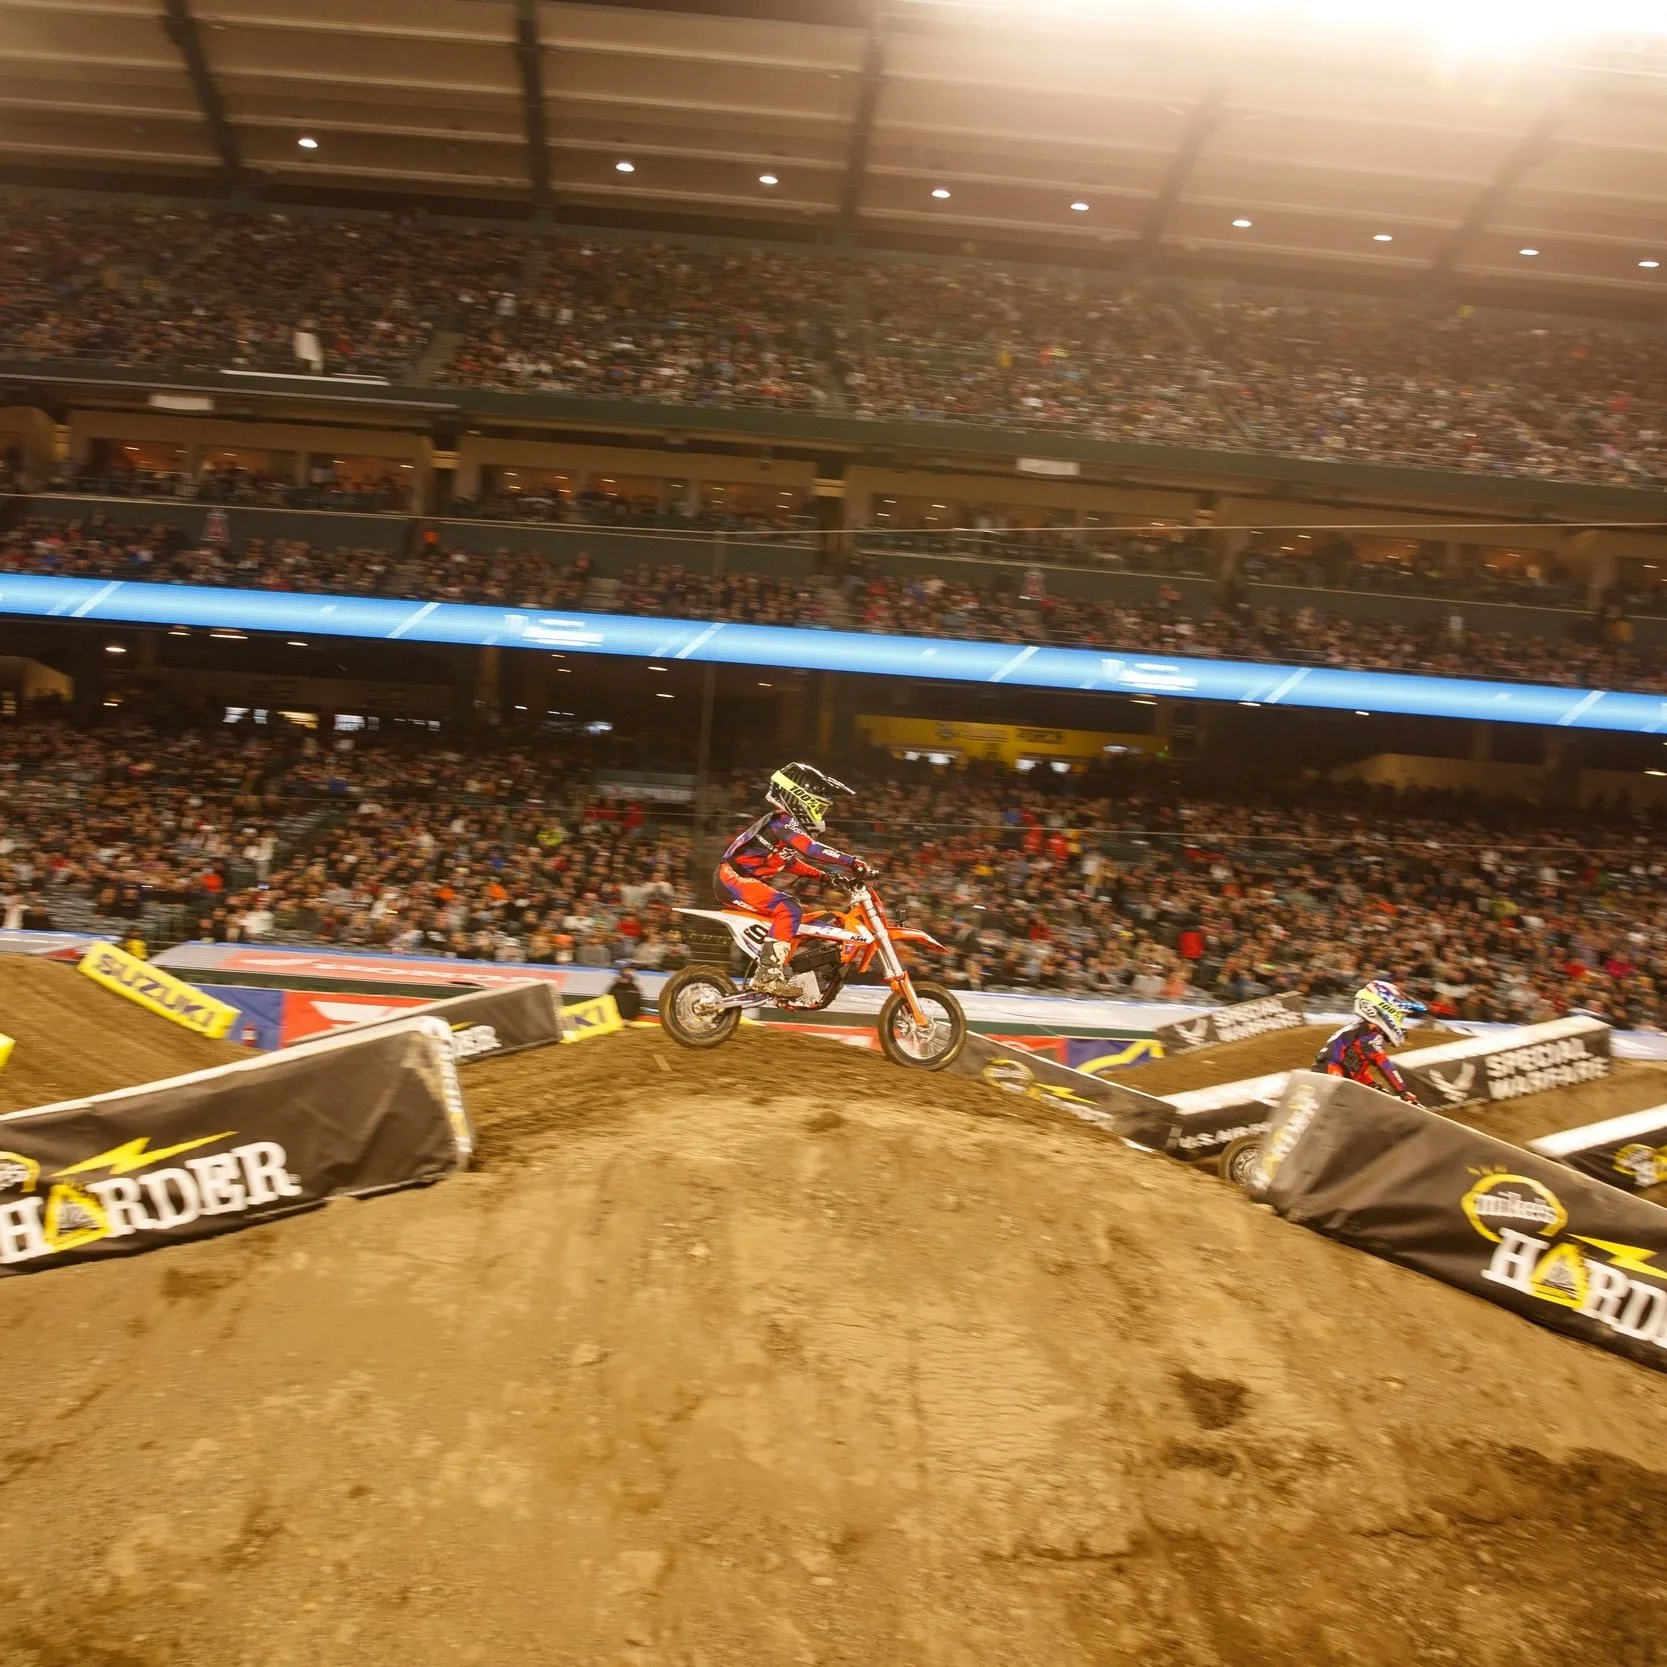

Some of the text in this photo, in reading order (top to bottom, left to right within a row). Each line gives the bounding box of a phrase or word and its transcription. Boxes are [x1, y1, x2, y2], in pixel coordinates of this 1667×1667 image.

[789, 785, 819, 810] 100%
[97, 953, 216, 1029] SUZUKI
[1213, 999, 1289, 1028] SPECIAL
[1485, 1037, 1593, 1078] SPECIAL
[1486, 1056, 1610, 1100] WARFARE
[0, 1141, 302, 1264] HARDER
[1480, 1226, 1667, 1350] HARD
